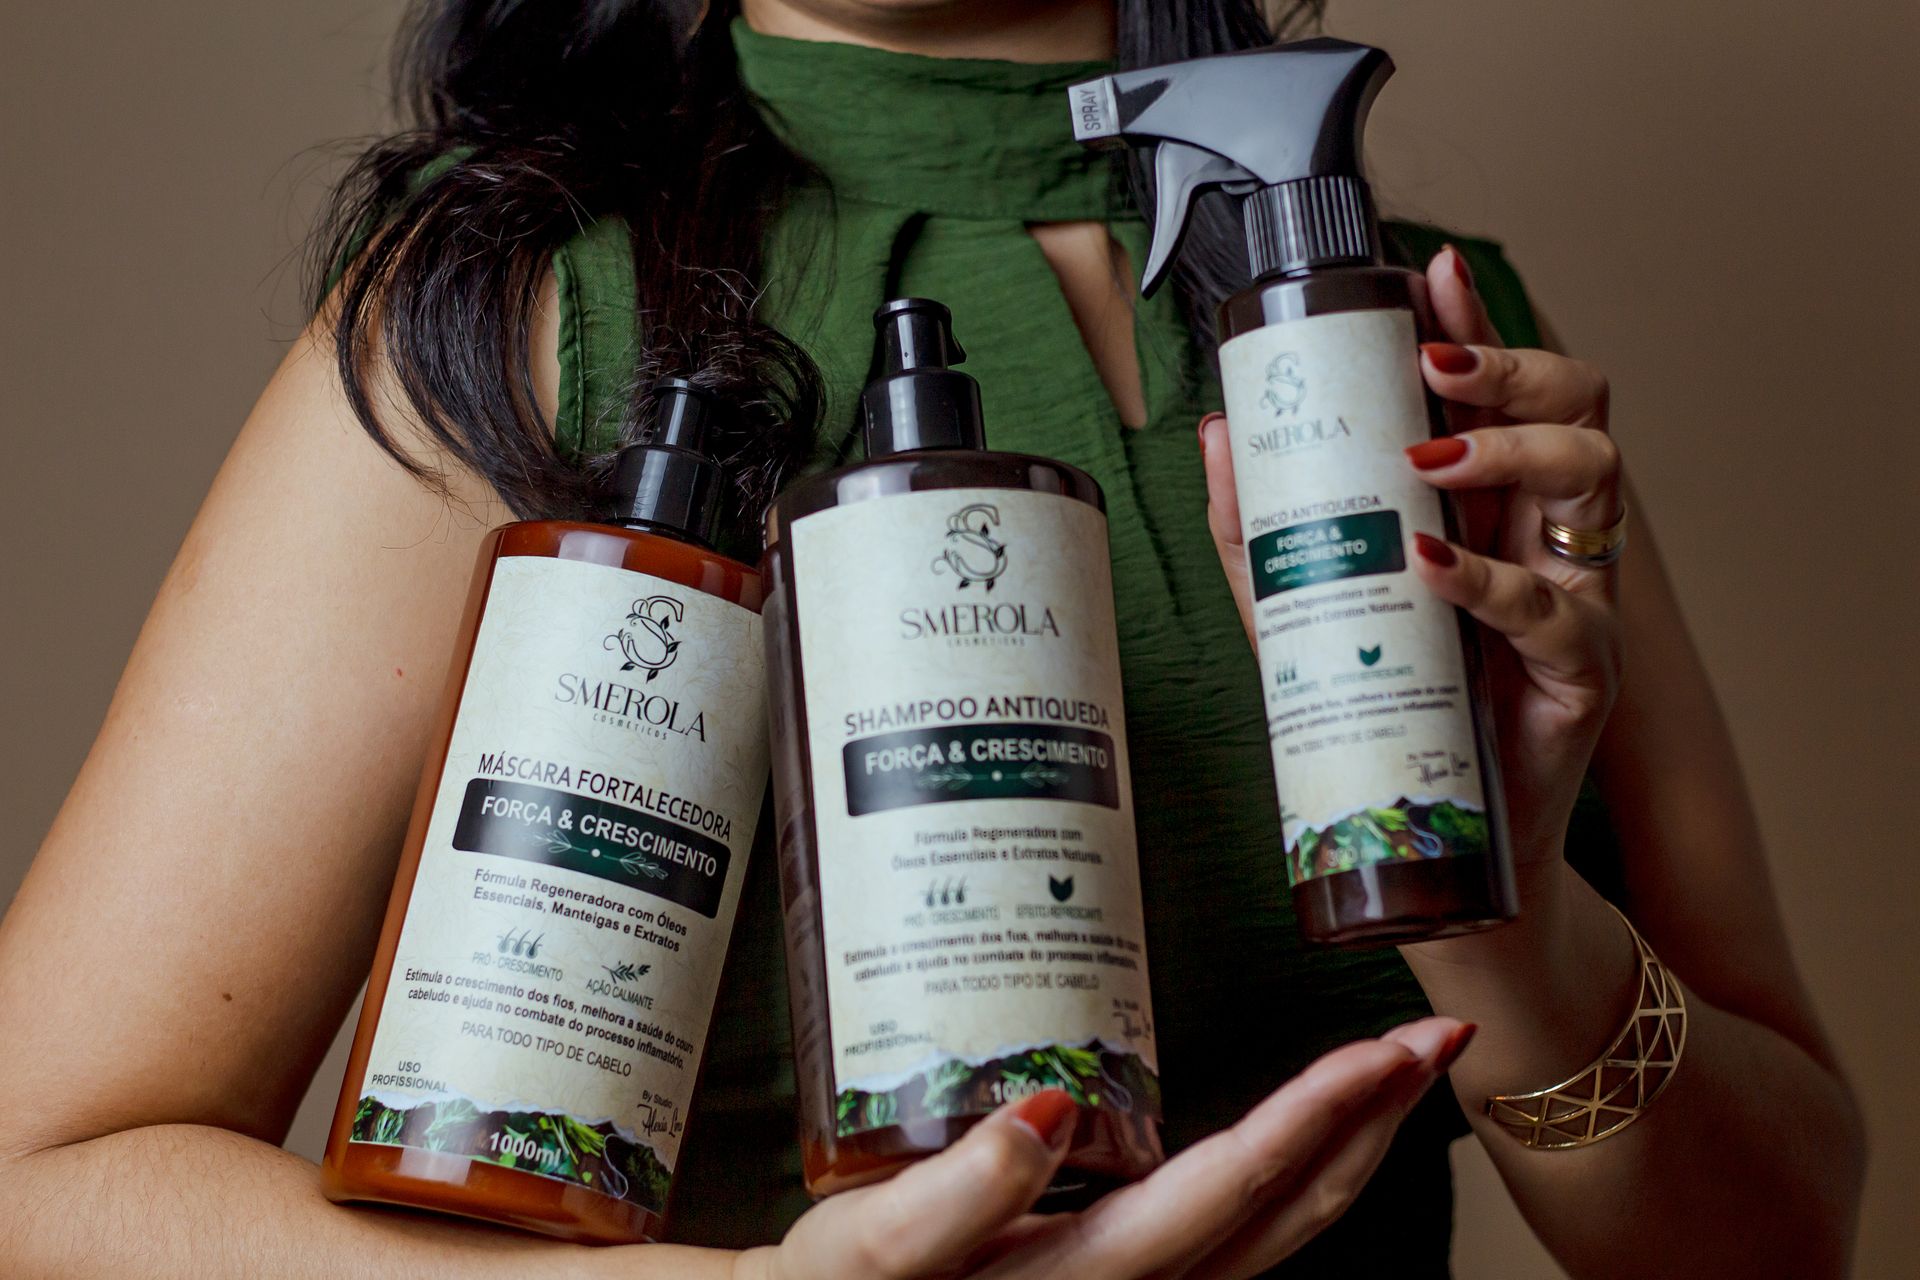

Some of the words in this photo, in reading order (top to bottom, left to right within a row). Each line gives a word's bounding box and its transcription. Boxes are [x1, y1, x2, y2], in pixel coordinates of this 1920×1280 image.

[1080, 89, 1100, 131] SPRAY
[1248, 416, 1352, 458] SMEROLA
[1290, 495, 1381, 520] ANTIQUEDA
[1328, 525, 1343, 541] &
[1264, 539, 1368, 574] CRESCIMENTO
[900, 602, 1060, 640] SMEROLA
[554, 673, 706, 743] SMEROLA
[845, 697, 978, 737] SHAMPOO
[985, 696, 1110, 731] ANTIQUEDA
[864, 743, 945, 775] FORÇA
[948, 740, 966, 764] &
[970, 738, 1108, 769] CRESCIMENTO
[477, 750, 571, 787] MÁSCARA
[576, 769, 732, 842] FORTALECEDORA
[480, 795, 553, 826] FORÇA
[557, 809, 573, 830] &
[579, 814, 717, 877] CRESCIMENTO
[972, 825, 1058, 841] Regeneradora
[930, 849, 998, 867] Essenciais
[1012, 845, 1060, 862] Extratos
[473, 887, 547, 913] Essenciais,
[551, 902, 619, 933] Manteigas
[623, 924, 631, 934] e
[633, 925, 680, 952] Extratos
[474, 868, 527, 889] Fórmula
[530, 878, 625, 914] Regeneradora
[628, 908, 654, 923] com
[656, 911, 687, 937] Óleos
[472, 951, 491, 966] PRÓ
[498, 956, 564, 982] CRESCIMENTO
[1003, 973, 1033, 990] TIPO
[1035, 972, 1052, 989] DE
[1055, 973, 1100, 990] CABELO
[405, 967, 443, 985] Estimula
[445, 975, 452, 985] o
[454, 974, 525, 998] crescimento
[527, 988, 549, 1004] dos
[552, 993, 577, 1013] fios,
[581, 1003, 626, 1026] melhora
[627, 1018, 634, 1028] a
[636, 1021, 663, 1040] saúde
[664, 1030, 675, 1045] do
[675, 1038, 694, 1054] couro
[585, 978, 611, 996] AÇÃO
[612, 986, 654, 1010] CALMANTE
[408, 987, 450, 1003] cabeludo
[453, 994, 459, 1004] e
[461, 994, 493, 1011] ajuda
[496, 1001, 511, 1014] no
[515, 1005, 566, 1027] combate
[568, 1017, 583, 1031] do
[585, 1023, 635, 1049] processo
[398, 1060, 422, 1073] USO
[461, 1020, 494, 1041] PARA
[496, 1027, 532, 1048] TODO
[535, 1036, 565, 1056] TIPO
[566, 1045, 584, 1062] DE
[586, 1051, 632, 1077] CABELO
[371, 1074, 449, 1094] PROFISSIONAL
[489, 1131, 562, 1165] 1000ml
